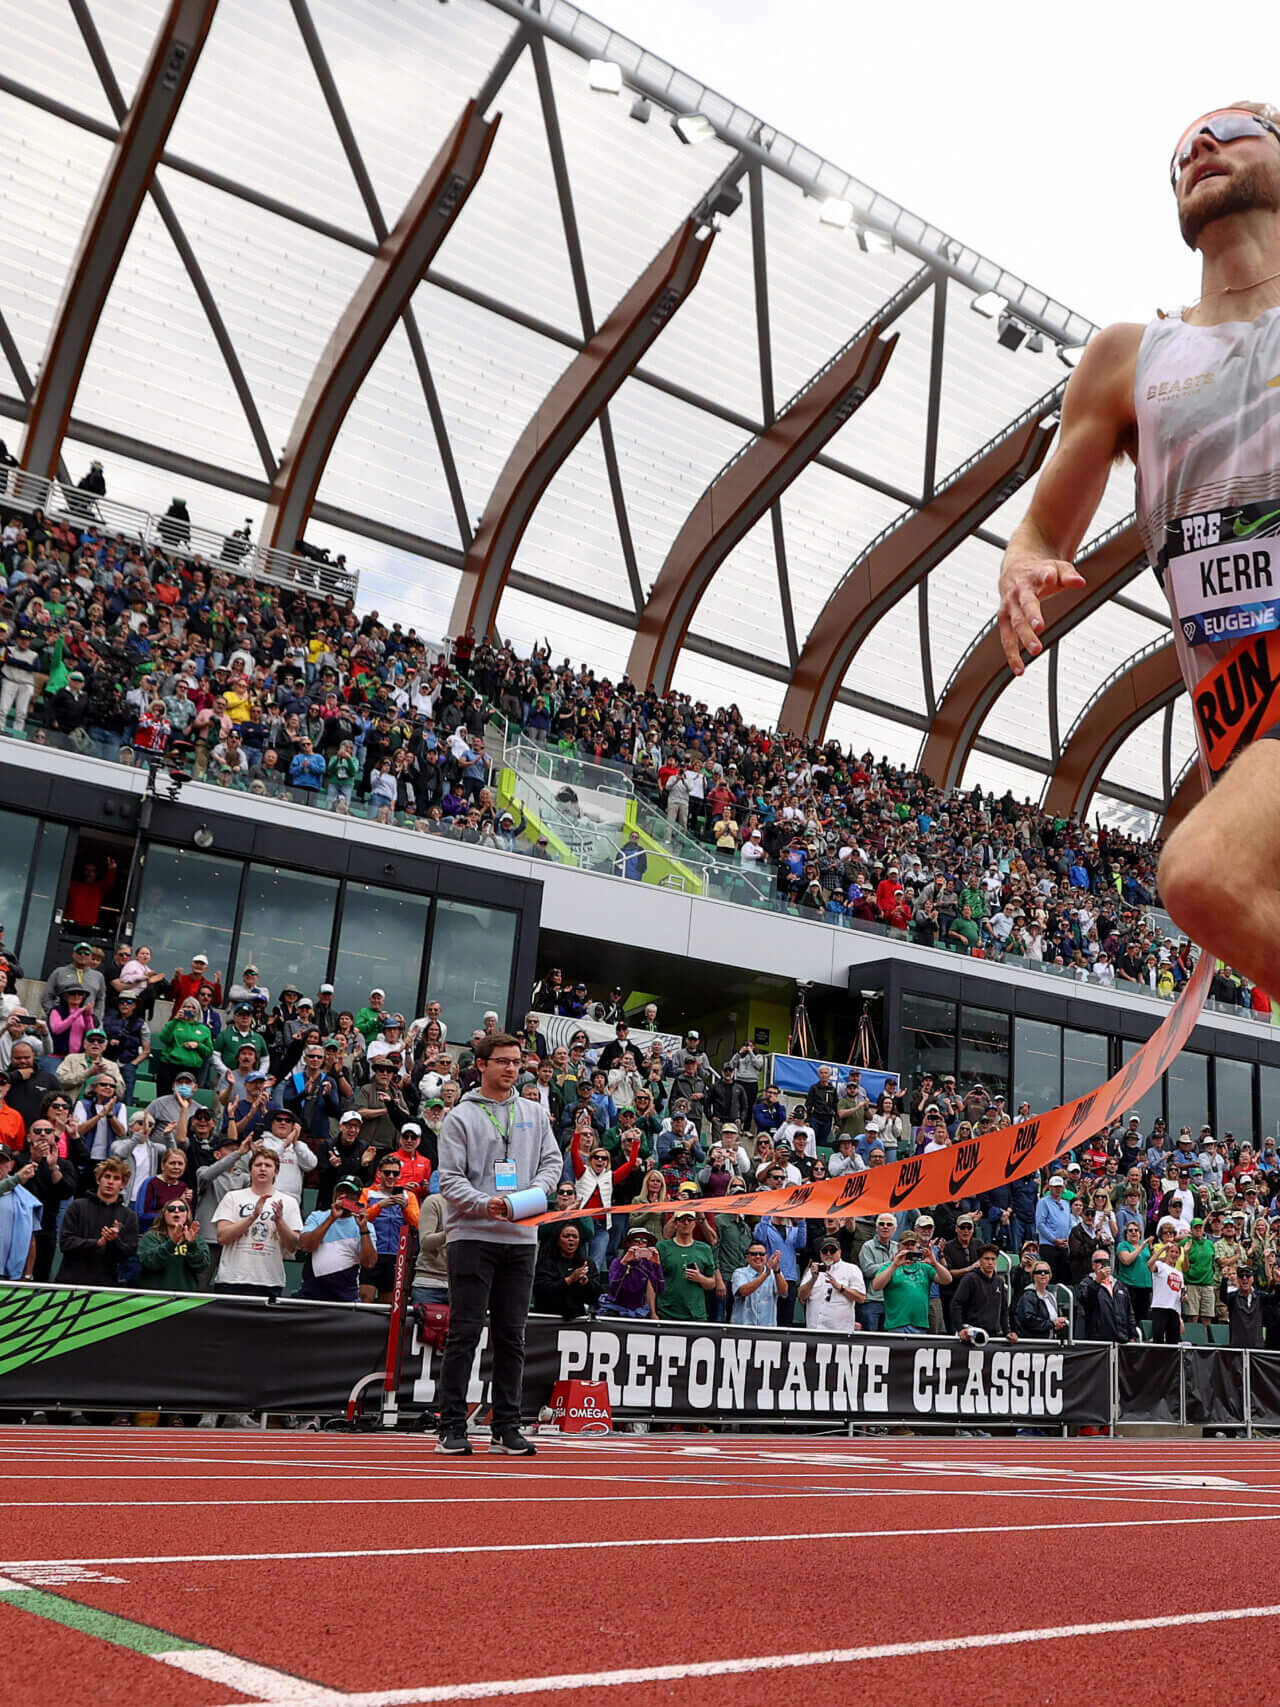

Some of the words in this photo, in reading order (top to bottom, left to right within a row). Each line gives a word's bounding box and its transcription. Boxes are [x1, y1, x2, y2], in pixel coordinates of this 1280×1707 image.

[1146, 372, 1215, 400] BEASTS
[1181, 512, 1221, 551] PRE
[1200, 550, 1273, 598] KERR
[1203, 607, 1275, 636] EUGENE
[1196, 635, 1272, 753] RUN
[1013, 1120, 1040, 1154] RUN
[955, 1143, 979, 1173] RUN
[840, 1173, 868, 1199] RUN
[898, 1159, 922, 1189] RUN
[783, 1186, 815, 1206] RUN
[393, 1254, 404, 1313] OMEGA
[557, 1330, 891, 1413] PREFONTAINE
[913, 1347, 1064, 1416] CLASSIC
[569, 1407, 609, 1419] OMEGA
